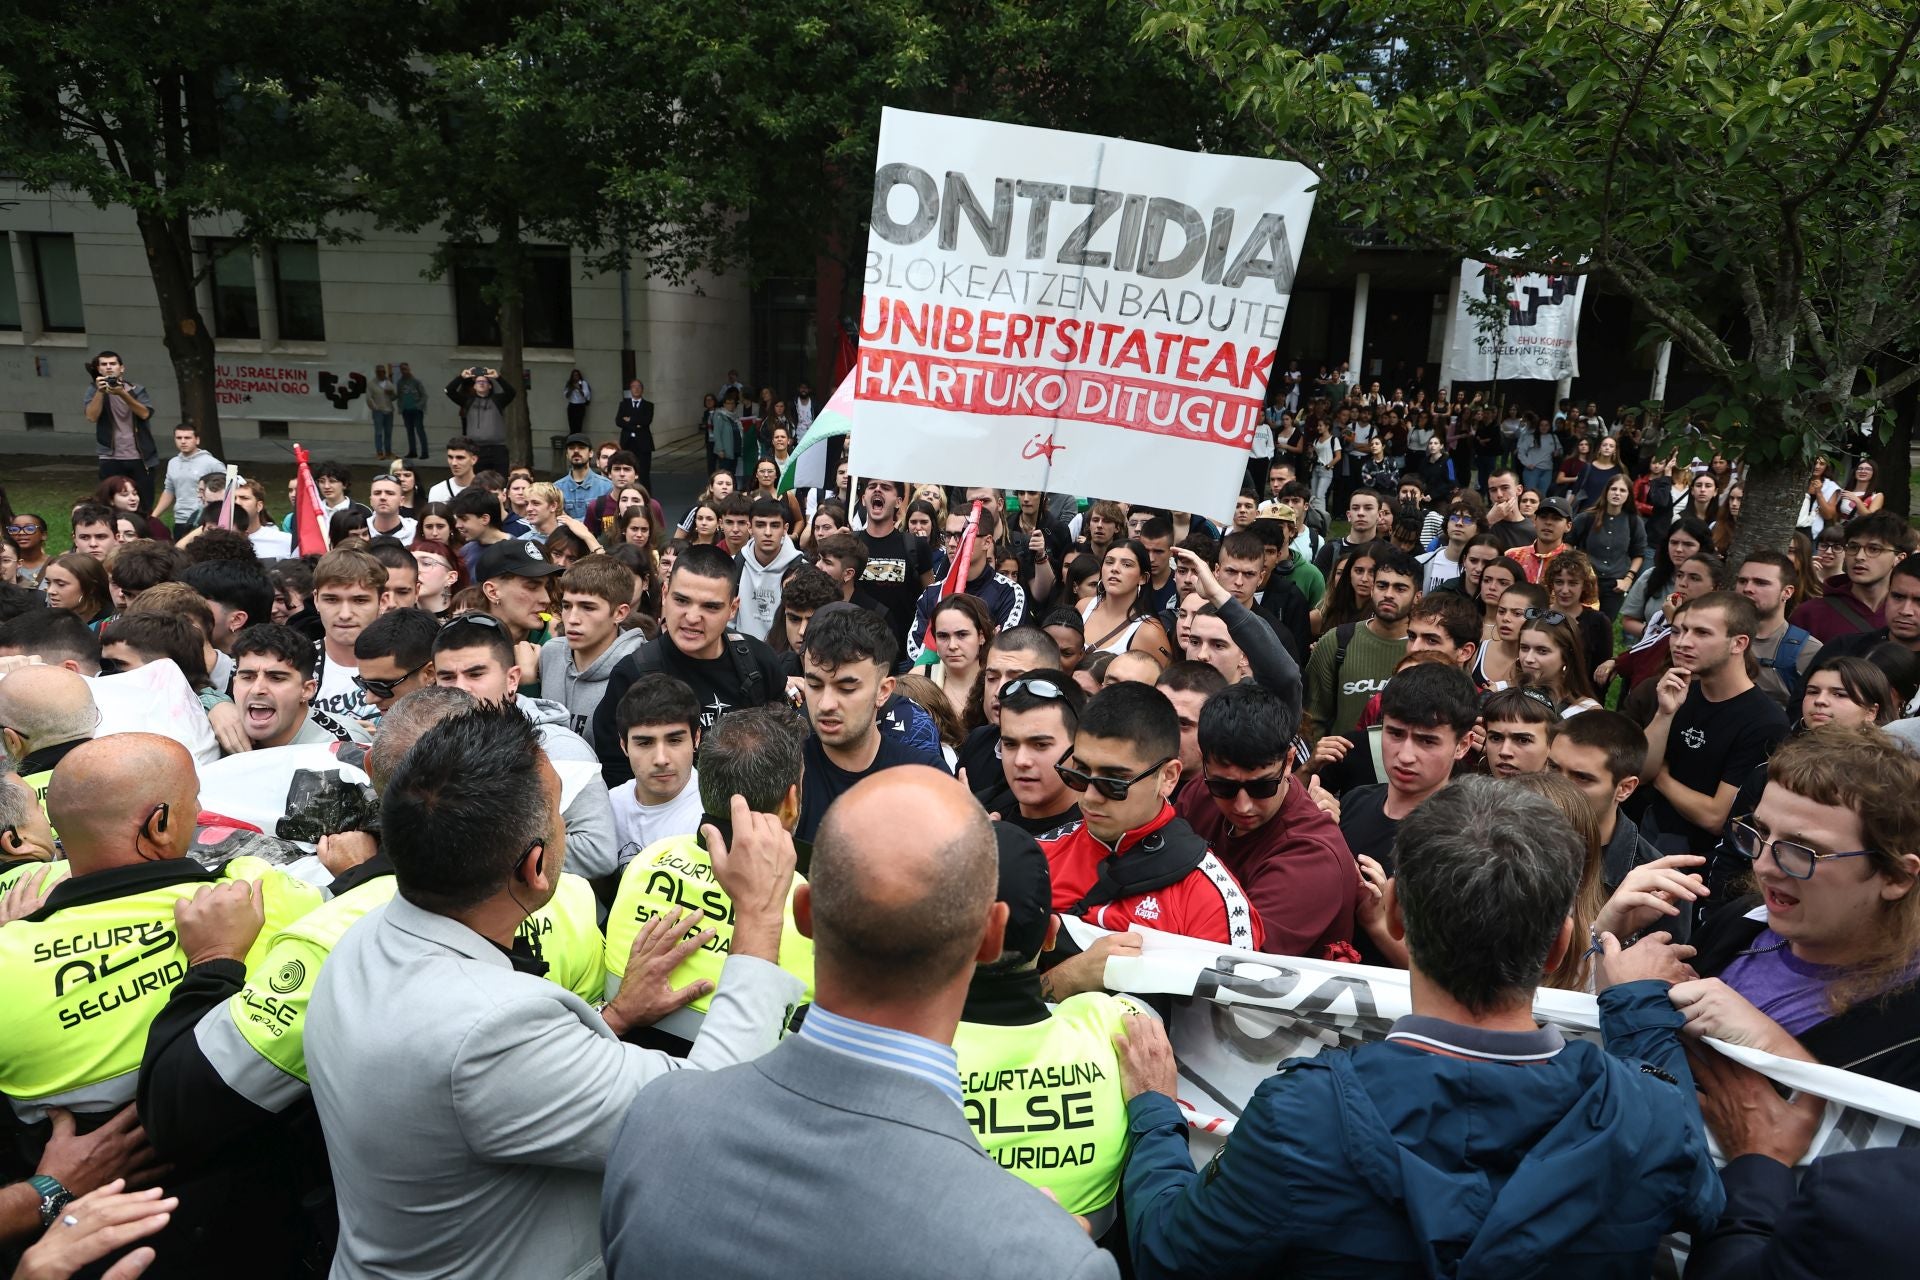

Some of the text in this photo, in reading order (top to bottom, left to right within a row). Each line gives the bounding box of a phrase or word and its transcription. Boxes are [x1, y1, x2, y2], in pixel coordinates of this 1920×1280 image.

[869, 162, 1297, 295] ONTZIDIA
[863, 250, 1285, 340] BLOKEATZEN BADUTE
[236, 366, 307, 381] ISRAELEKIN
[858, 294, 1277, 392] UNIBERTSITATEAK
[281, 382, 310, 395] ORO
[859, 355, 1258, 444] HARTUKO DITUGU!
[58, 960, 184, 1030] SEGURID
[963, 1091, 1095, 1135] ALSE
[986, 1142, 1096, 1170] URIDAD
